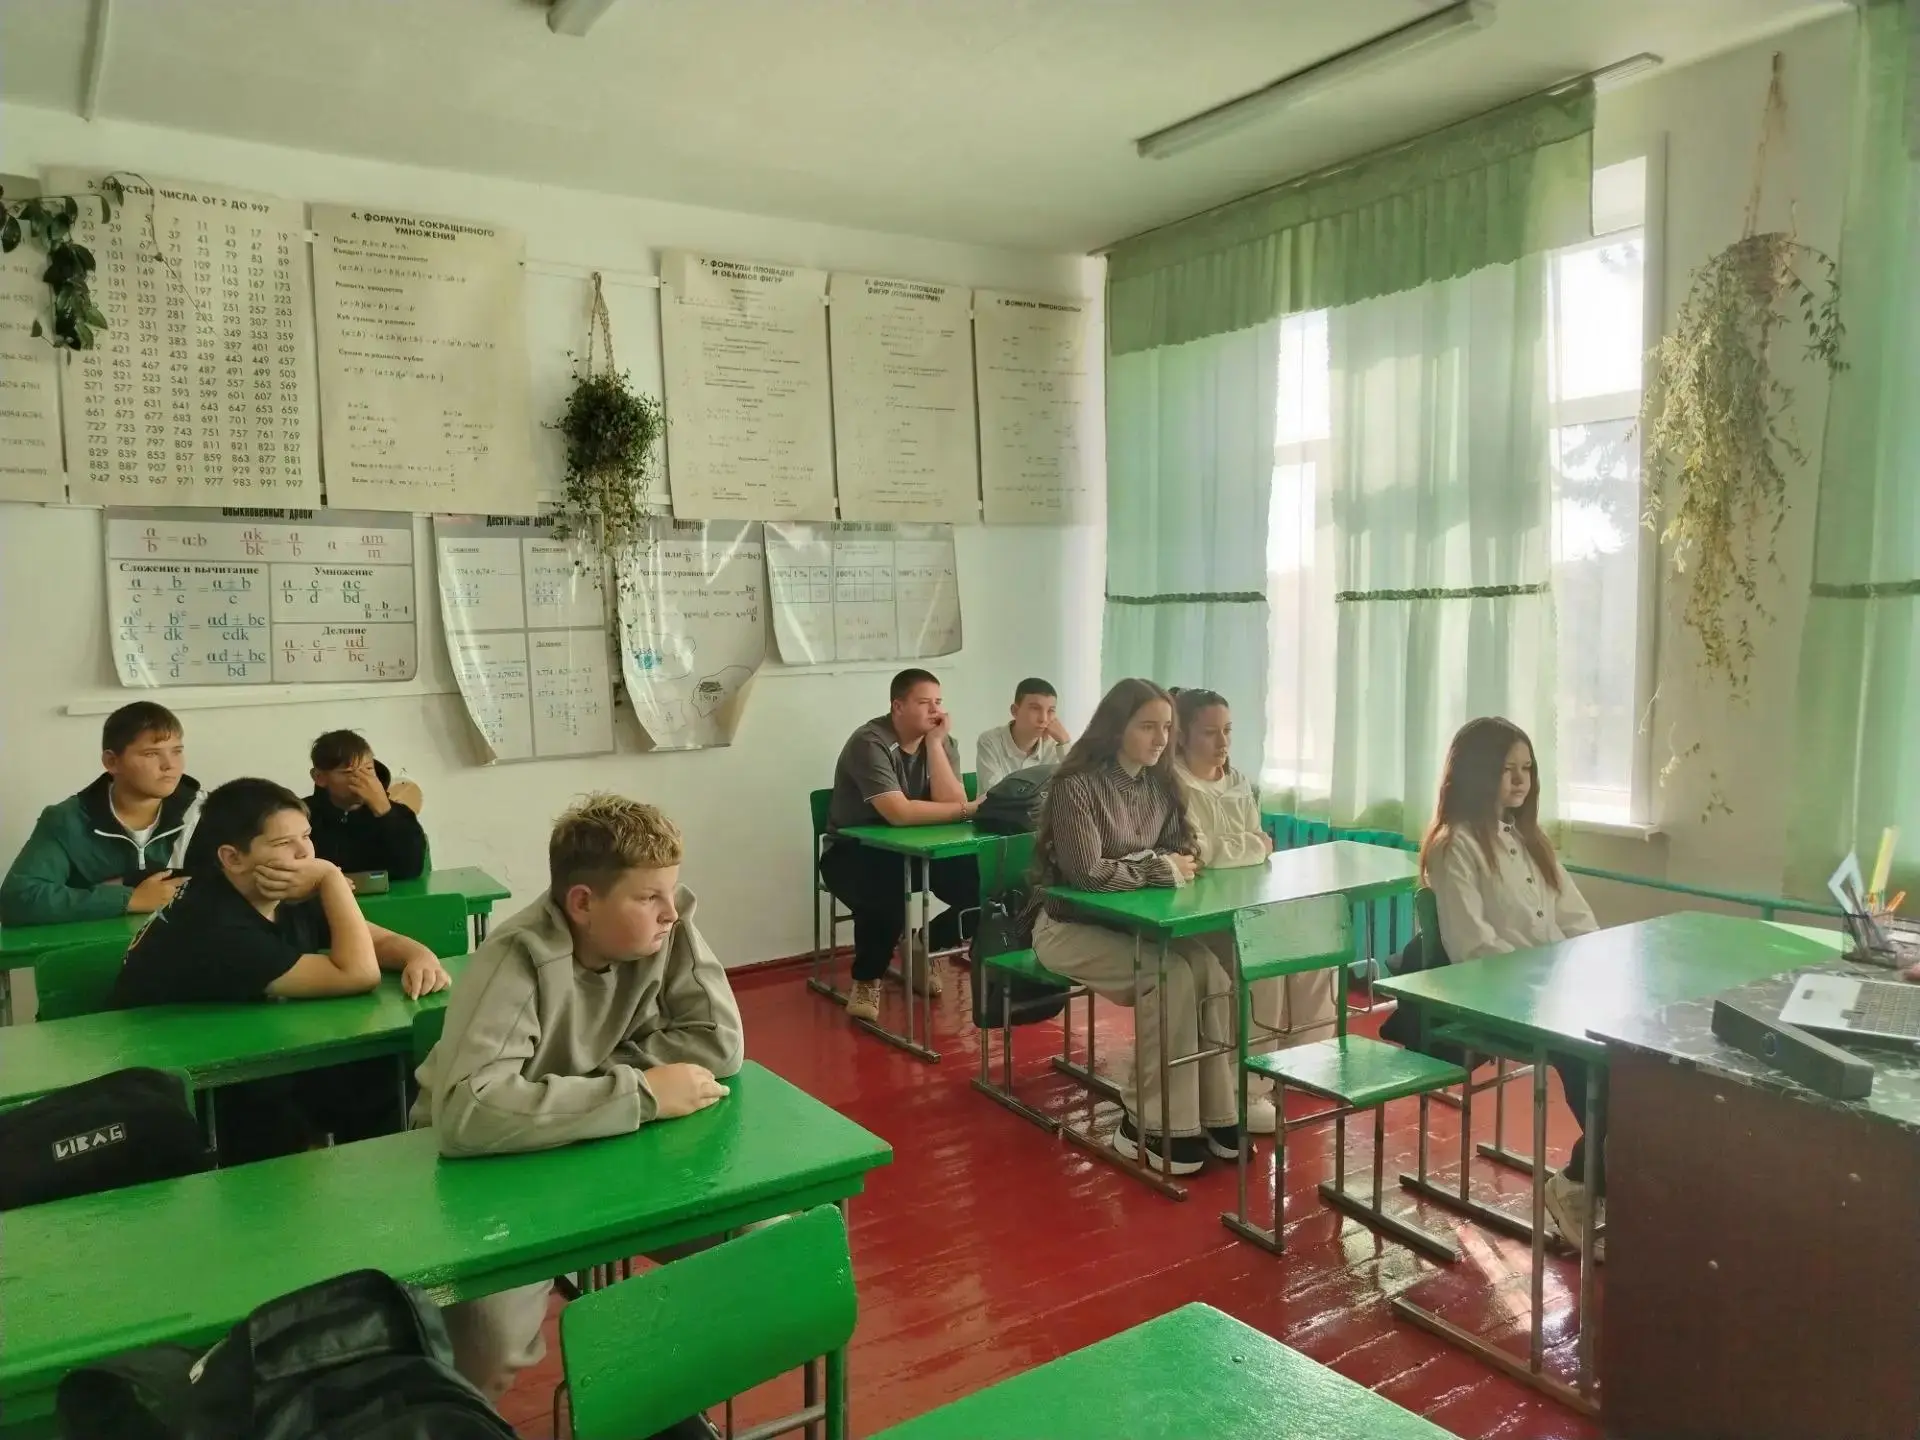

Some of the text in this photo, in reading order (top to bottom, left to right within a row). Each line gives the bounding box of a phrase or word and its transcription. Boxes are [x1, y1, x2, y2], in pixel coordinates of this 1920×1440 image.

[160, 190, 198, 202] ЧИСЛА
[202, 196, 216, 206] ОТ
[221, 198, 227, 207] 2
[231, 199, 247, 211] ДО
[252, 203, 270, 214] 997
[351, 212, 494, 238] 4. ФОРМУЛЫ СОКРАЩЕННОГО
[395, 226, 456, 241] УМНОЖЕНИЯ
[710, 260, 750, 271] ФОРМУЛЫ
[120, 563, 180, 574] Сложение
[194, 566, 260, 575] вычитание
[314, 567, 374, 577] Умножение
[322, 626, 367, 636] Деление
